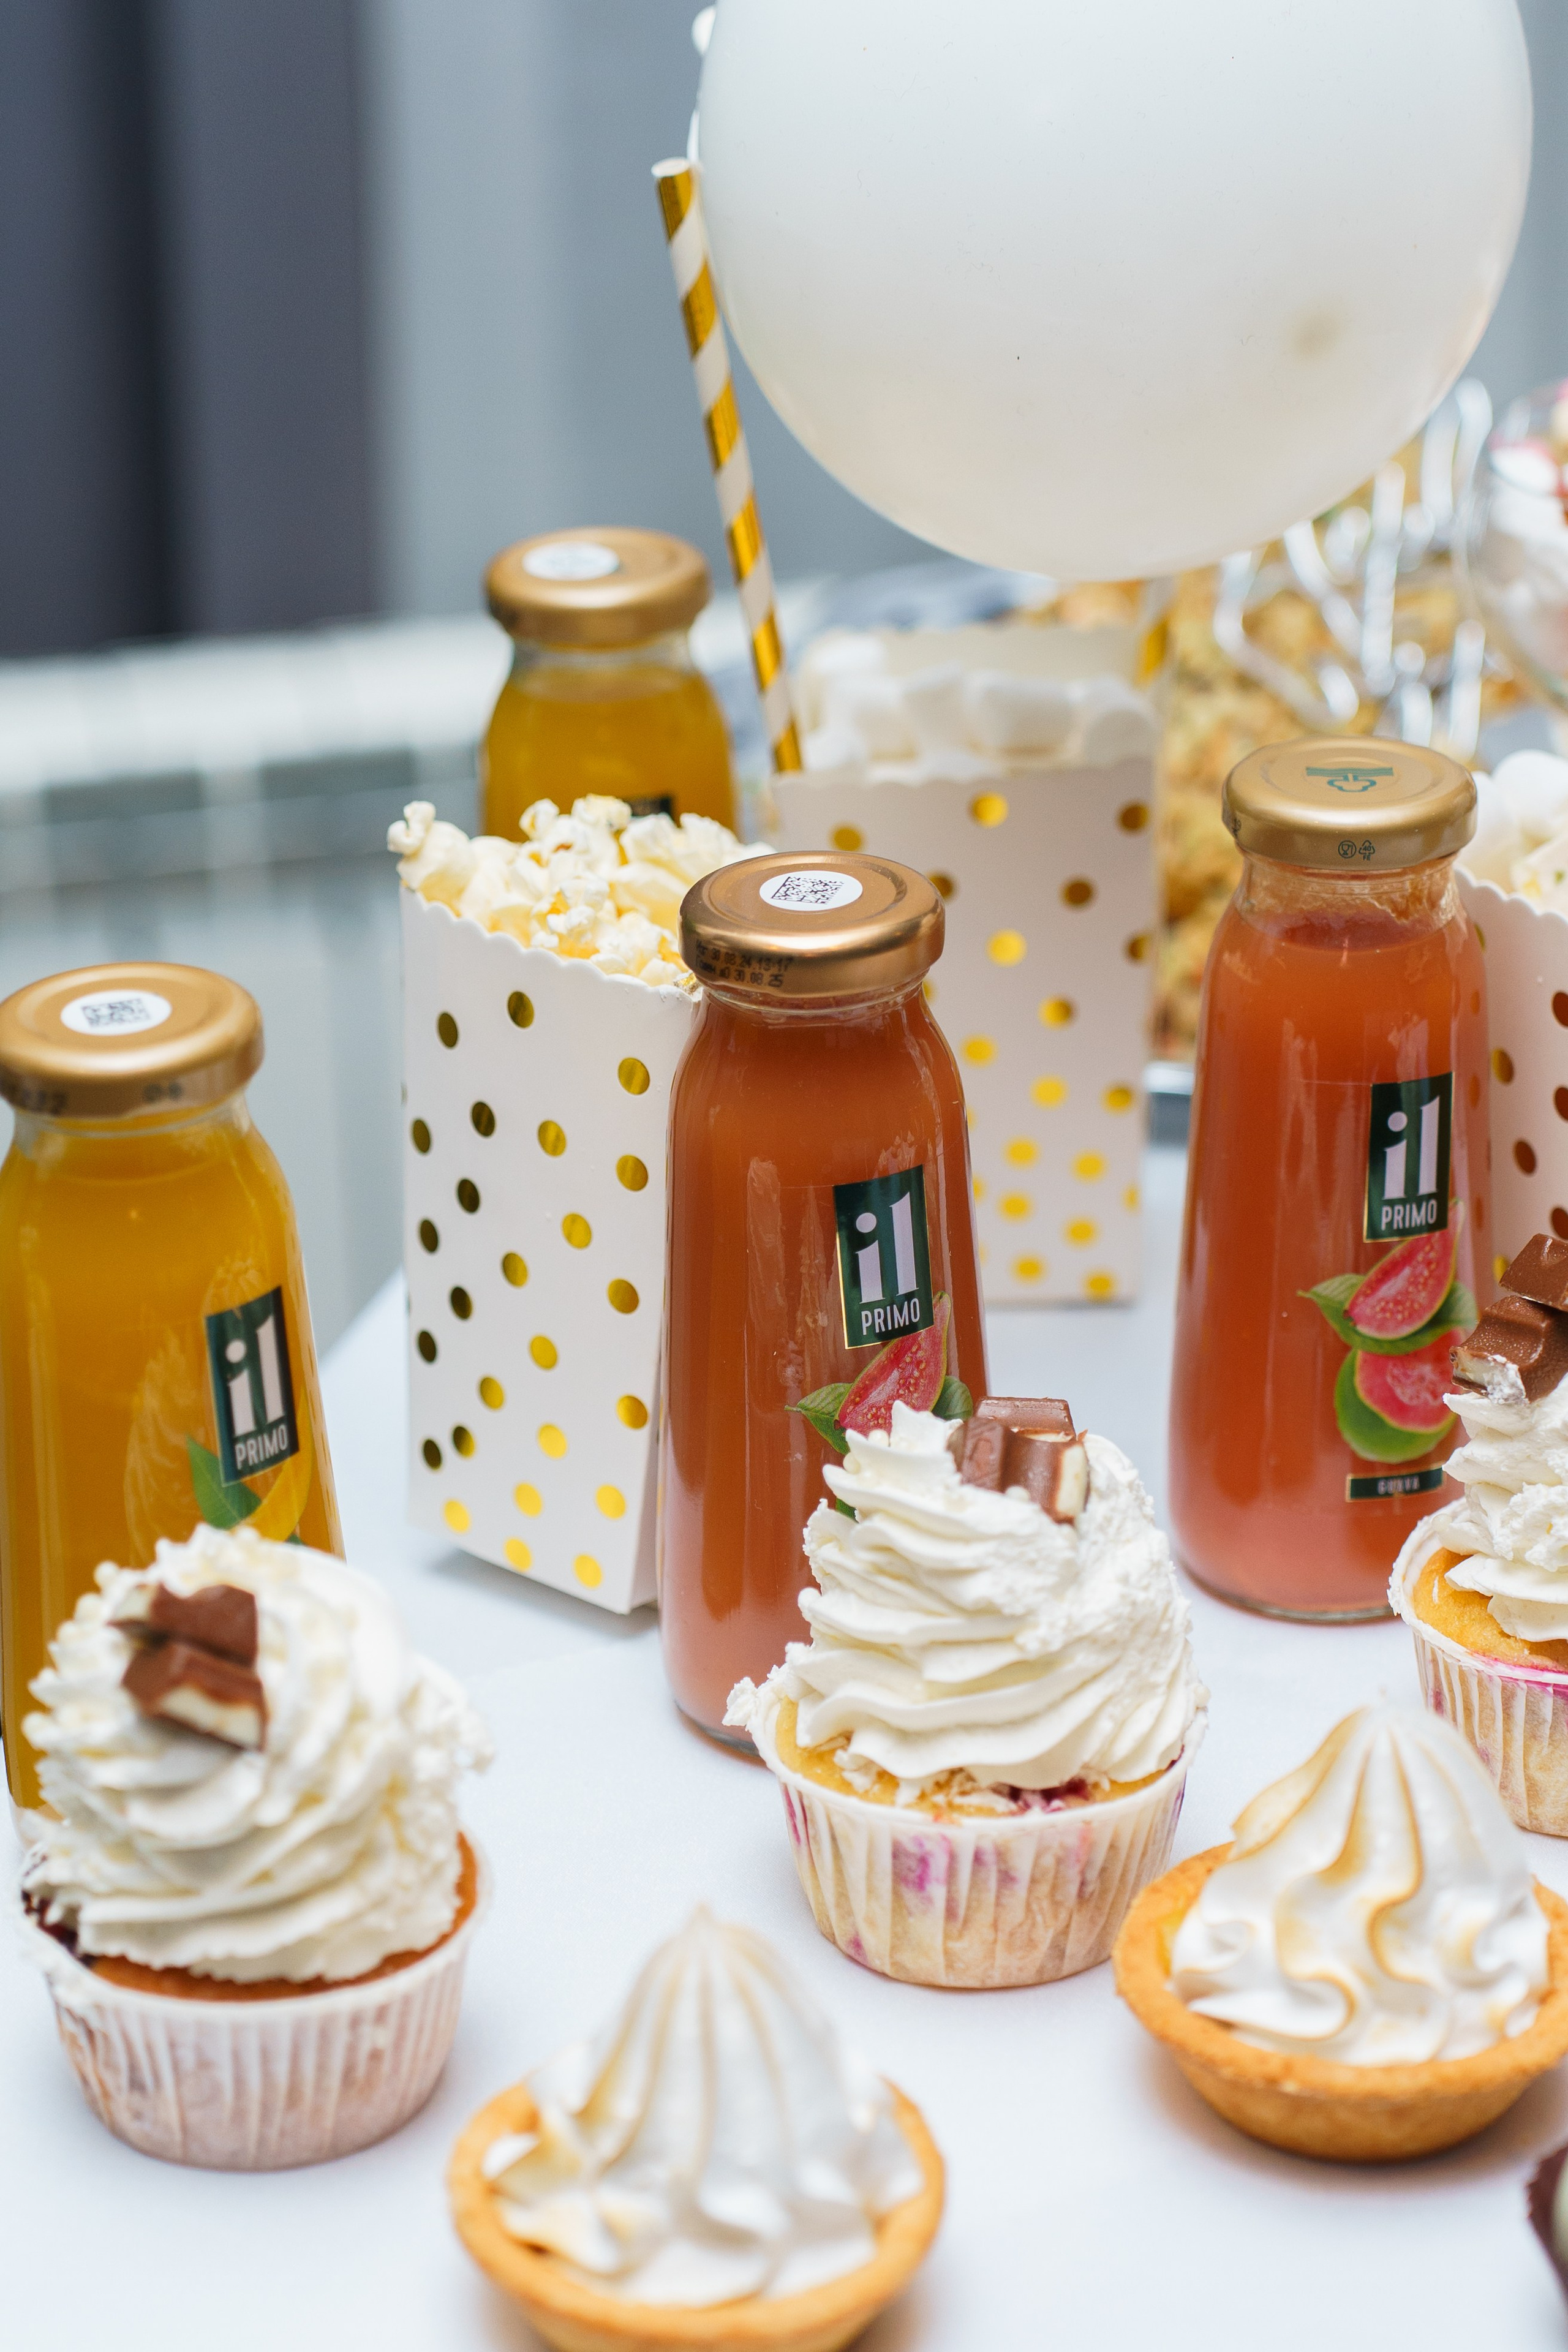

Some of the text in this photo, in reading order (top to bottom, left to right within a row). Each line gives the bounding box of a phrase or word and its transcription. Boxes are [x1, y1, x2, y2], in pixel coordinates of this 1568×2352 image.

[1381, 1199, 1438, 1231] PRIMO
[861, 1298, 921, 1336] PRIMO
[235, 1423, 288, 1470] PRIMO
